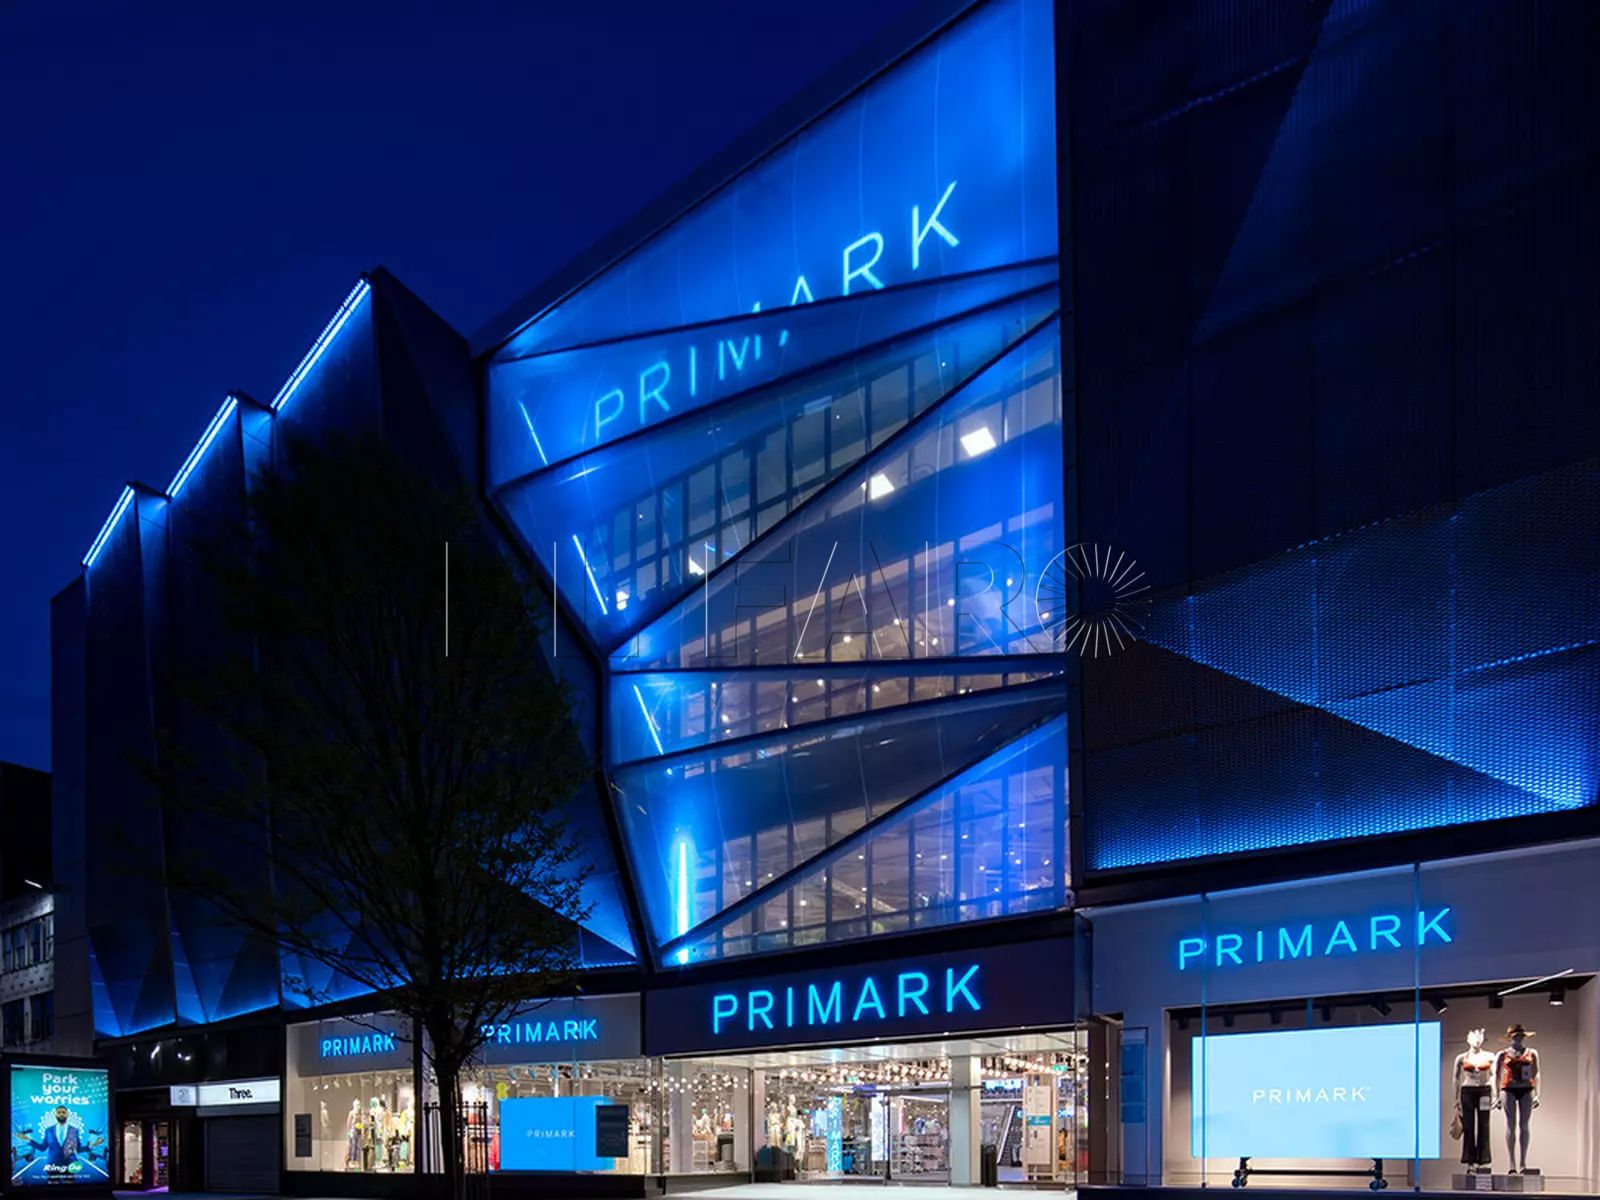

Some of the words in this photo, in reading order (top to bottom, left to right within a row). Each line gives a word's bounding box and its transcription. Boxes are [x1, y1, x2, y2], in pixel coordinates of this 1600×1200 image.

[1178, 907, 1453, 972] PRIMARK
[712, 964, 982, 1035] PRIMARK
[322, 1032, 395, 1057] PRIMARK
[42, 1072, 79, 1085] Park
[42, 1084, 79, 1096] your
[1251, 1087, 1367, 1104] PRIMARK
[30, 1094, 90, 1105] worries
[527, 1129, 576, 1139] PRIMARK
